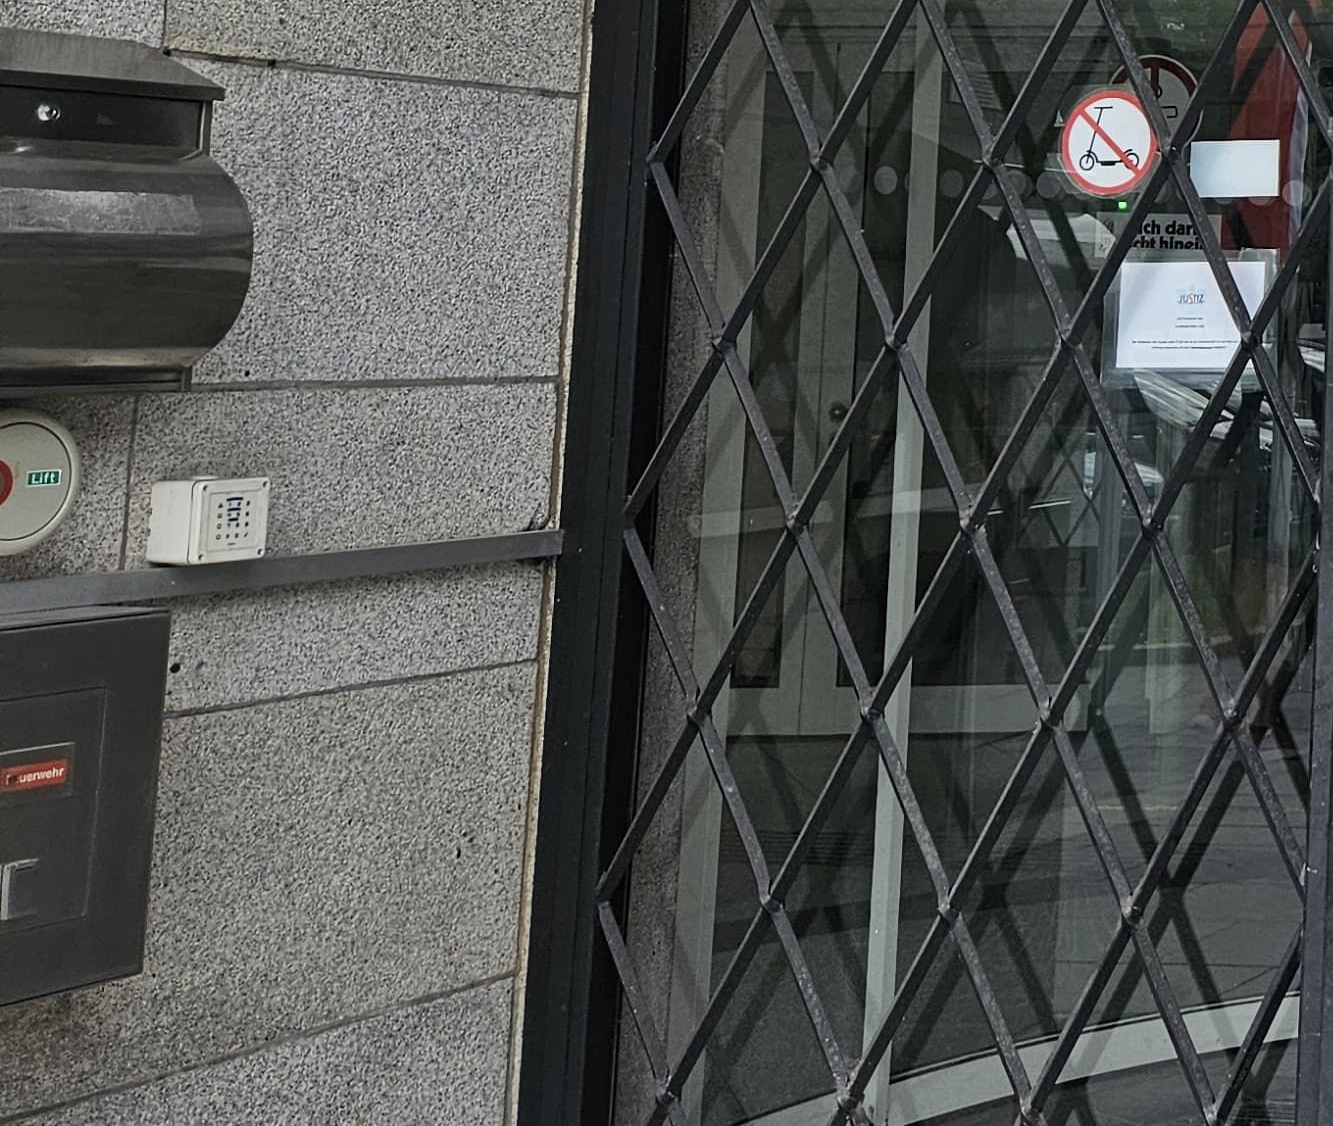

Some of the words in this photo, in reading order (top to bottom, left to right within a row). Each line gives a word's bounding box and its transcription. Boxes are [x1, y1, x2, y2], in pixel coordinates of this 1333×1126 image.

[1165, 220, 1198, 235] dar
[1129, 236, 1155, 249] cht
[1160, 236, 1203, 250] hinei
[1178, 293, 1205, 305] JUSTIZ
[31, 472, 55, 484] Lift
